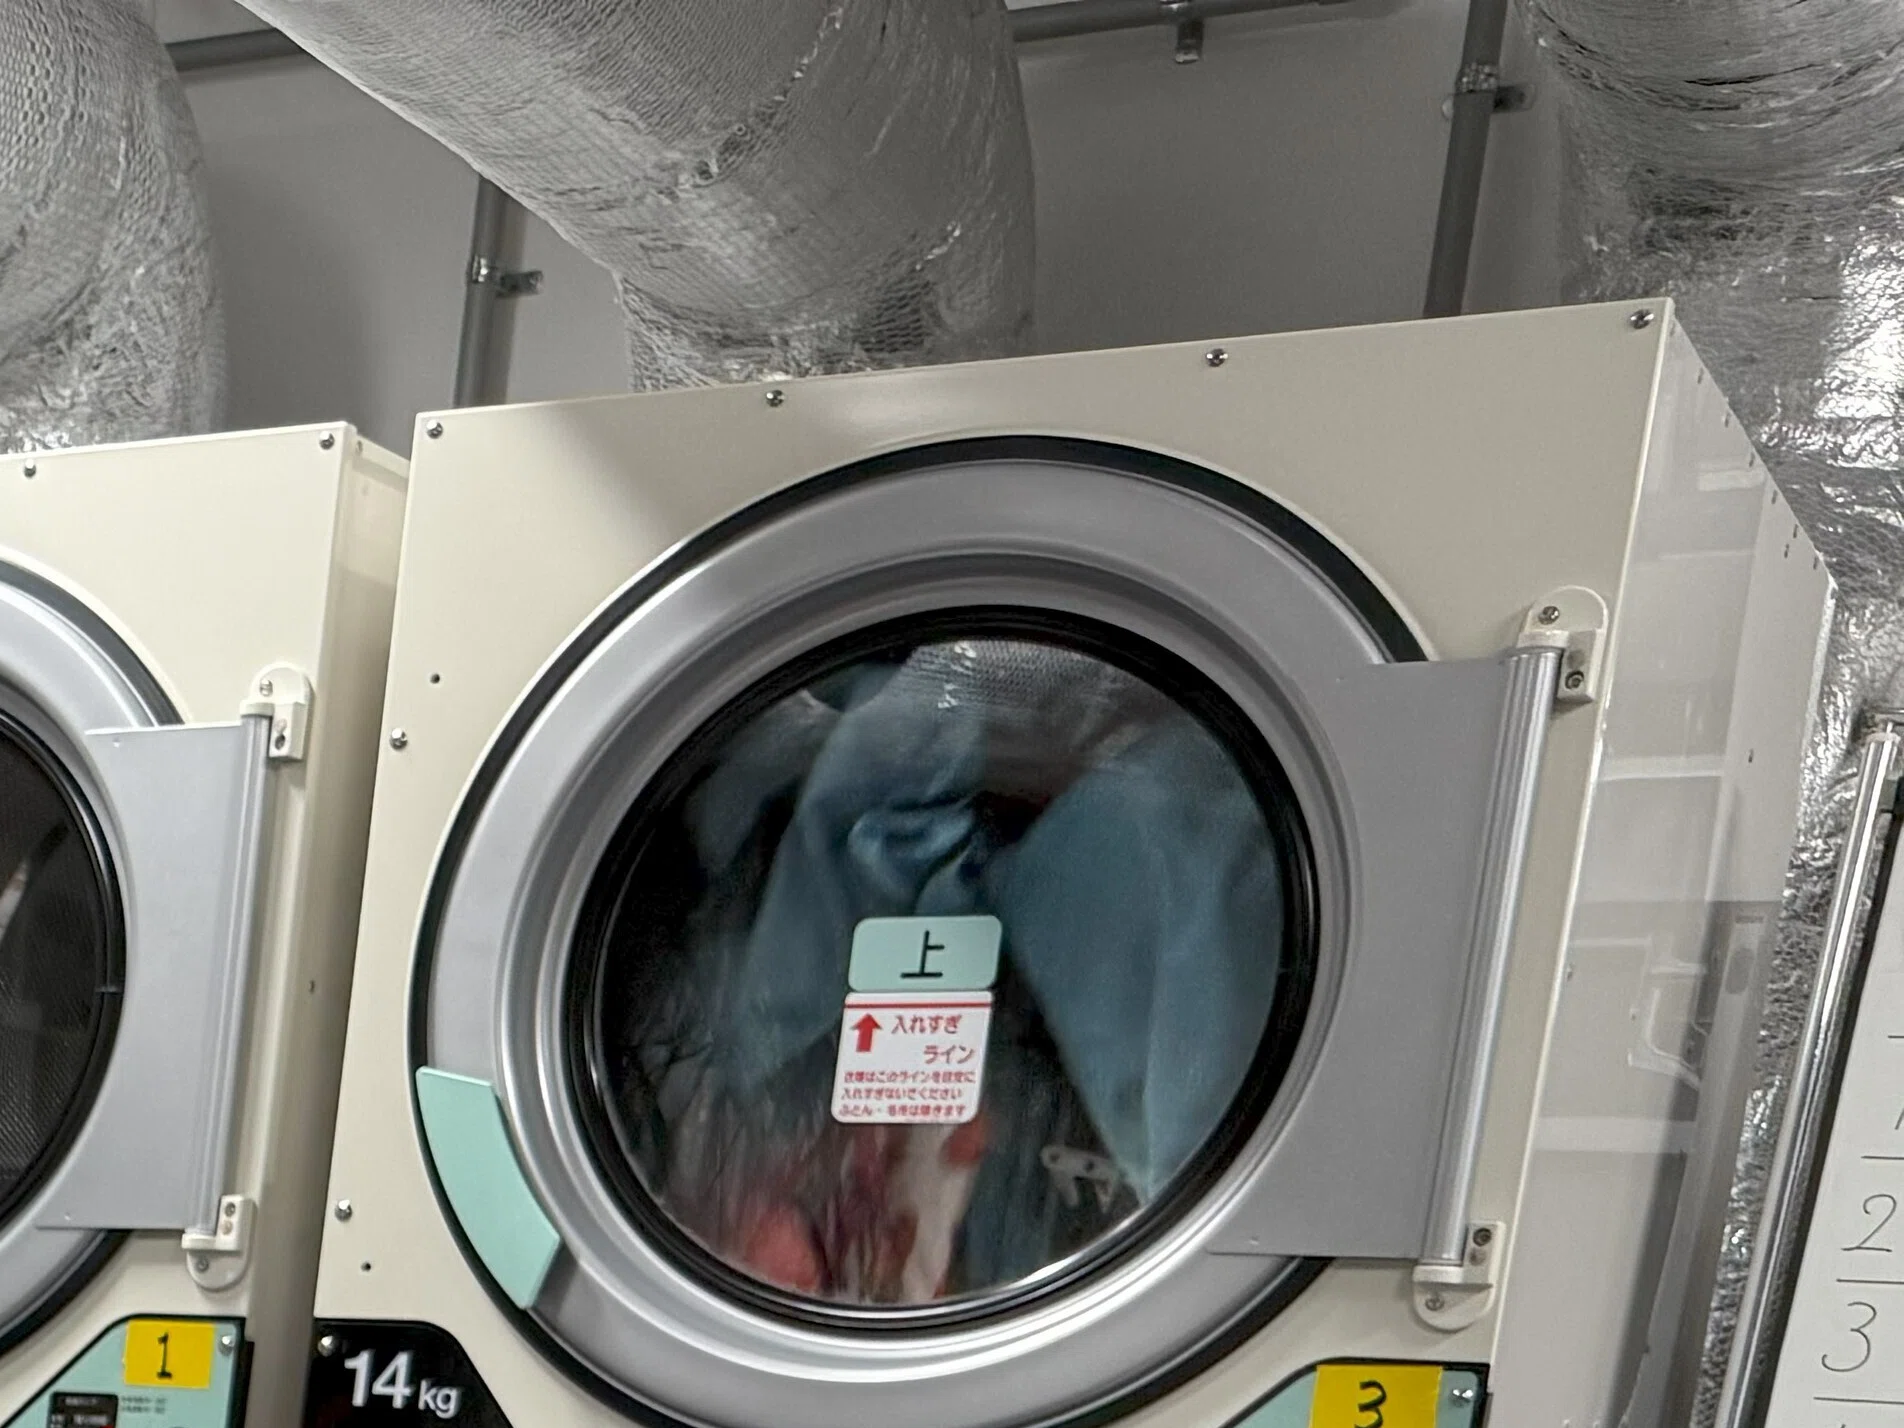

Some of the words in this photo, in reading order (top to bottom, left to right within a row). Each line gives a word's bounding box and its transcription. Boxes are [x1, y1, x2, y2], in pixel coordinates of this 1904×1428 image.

[900, 929, 945, 979] 上
[891, 1014, 962, 1035] 入れすぎ
[923, 1044, 975, 1065] ライン
[1841, 1194, 1897, 1253] 2
[156, 1331, 173, 1380] 1
[1821, 1301, 1877, 1373] 3
[344, 1349, 461, 1419] 14kg
